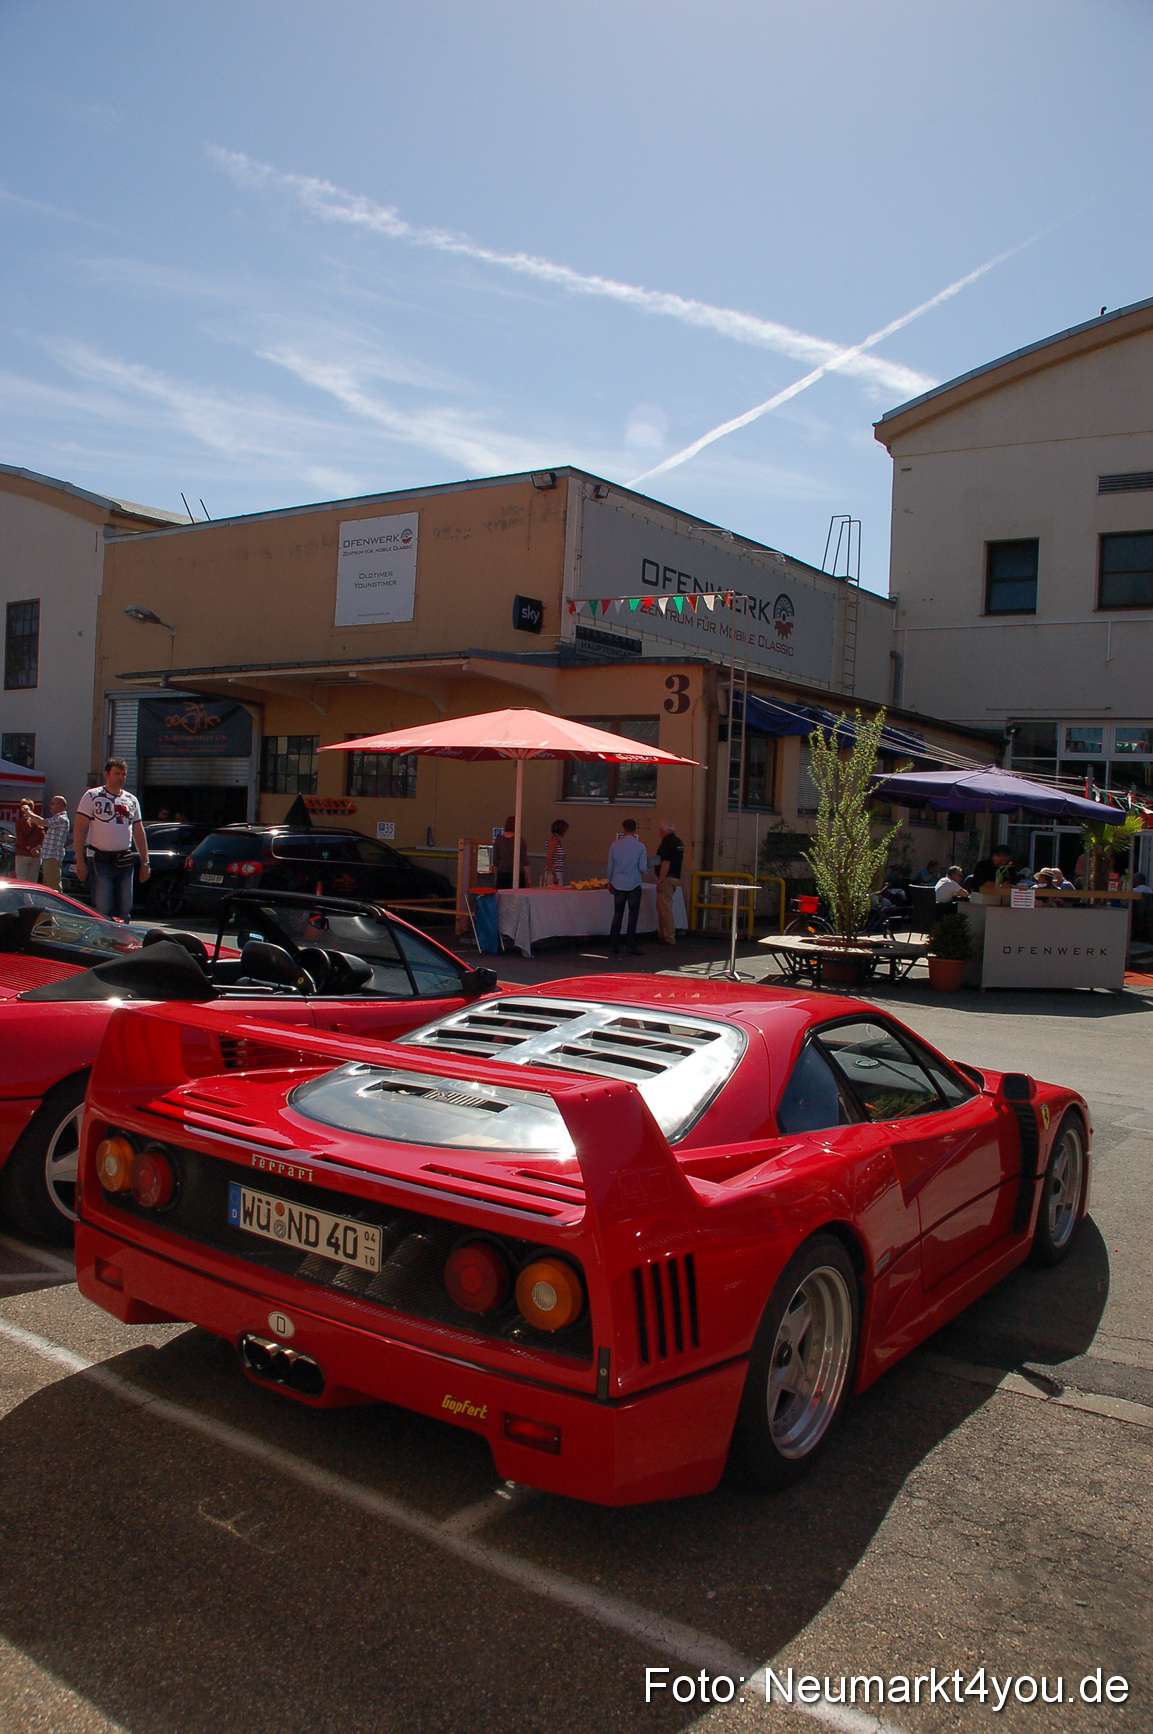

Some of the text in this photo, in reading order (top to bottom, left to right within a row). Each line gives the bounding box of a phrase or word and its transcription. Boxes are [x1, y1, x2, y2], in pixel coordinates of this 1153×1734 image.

[343, 533, 401, 549] OFENWERK
[358, 570, 394, 580] OLDTIMER
[354, 579, 398, 590] YOUNGTIMER
[521, 604, 540, 625] sky
[640, 602, 693, 627] ZENTRUM
[696, 615, 716, 634] FÜR
[758, 634, 794, 657] CLASSIC
[663, 674, 691, 715] 3
[94, 802, 113, 816] 34
[385, 823, 394, 834] 35
[1002, 946, 1108, 956] OFENWERK
[251, 1153, 313, 1182] Ferrari
[231, 1208, 237, 1219] D
[242, 1192, 358, 1261] WÜ ND 40
[364, 1230, 376, 1243] 04
[364, 1253, 376, 1267] 10
[276, 1315, 286, 1334] D
